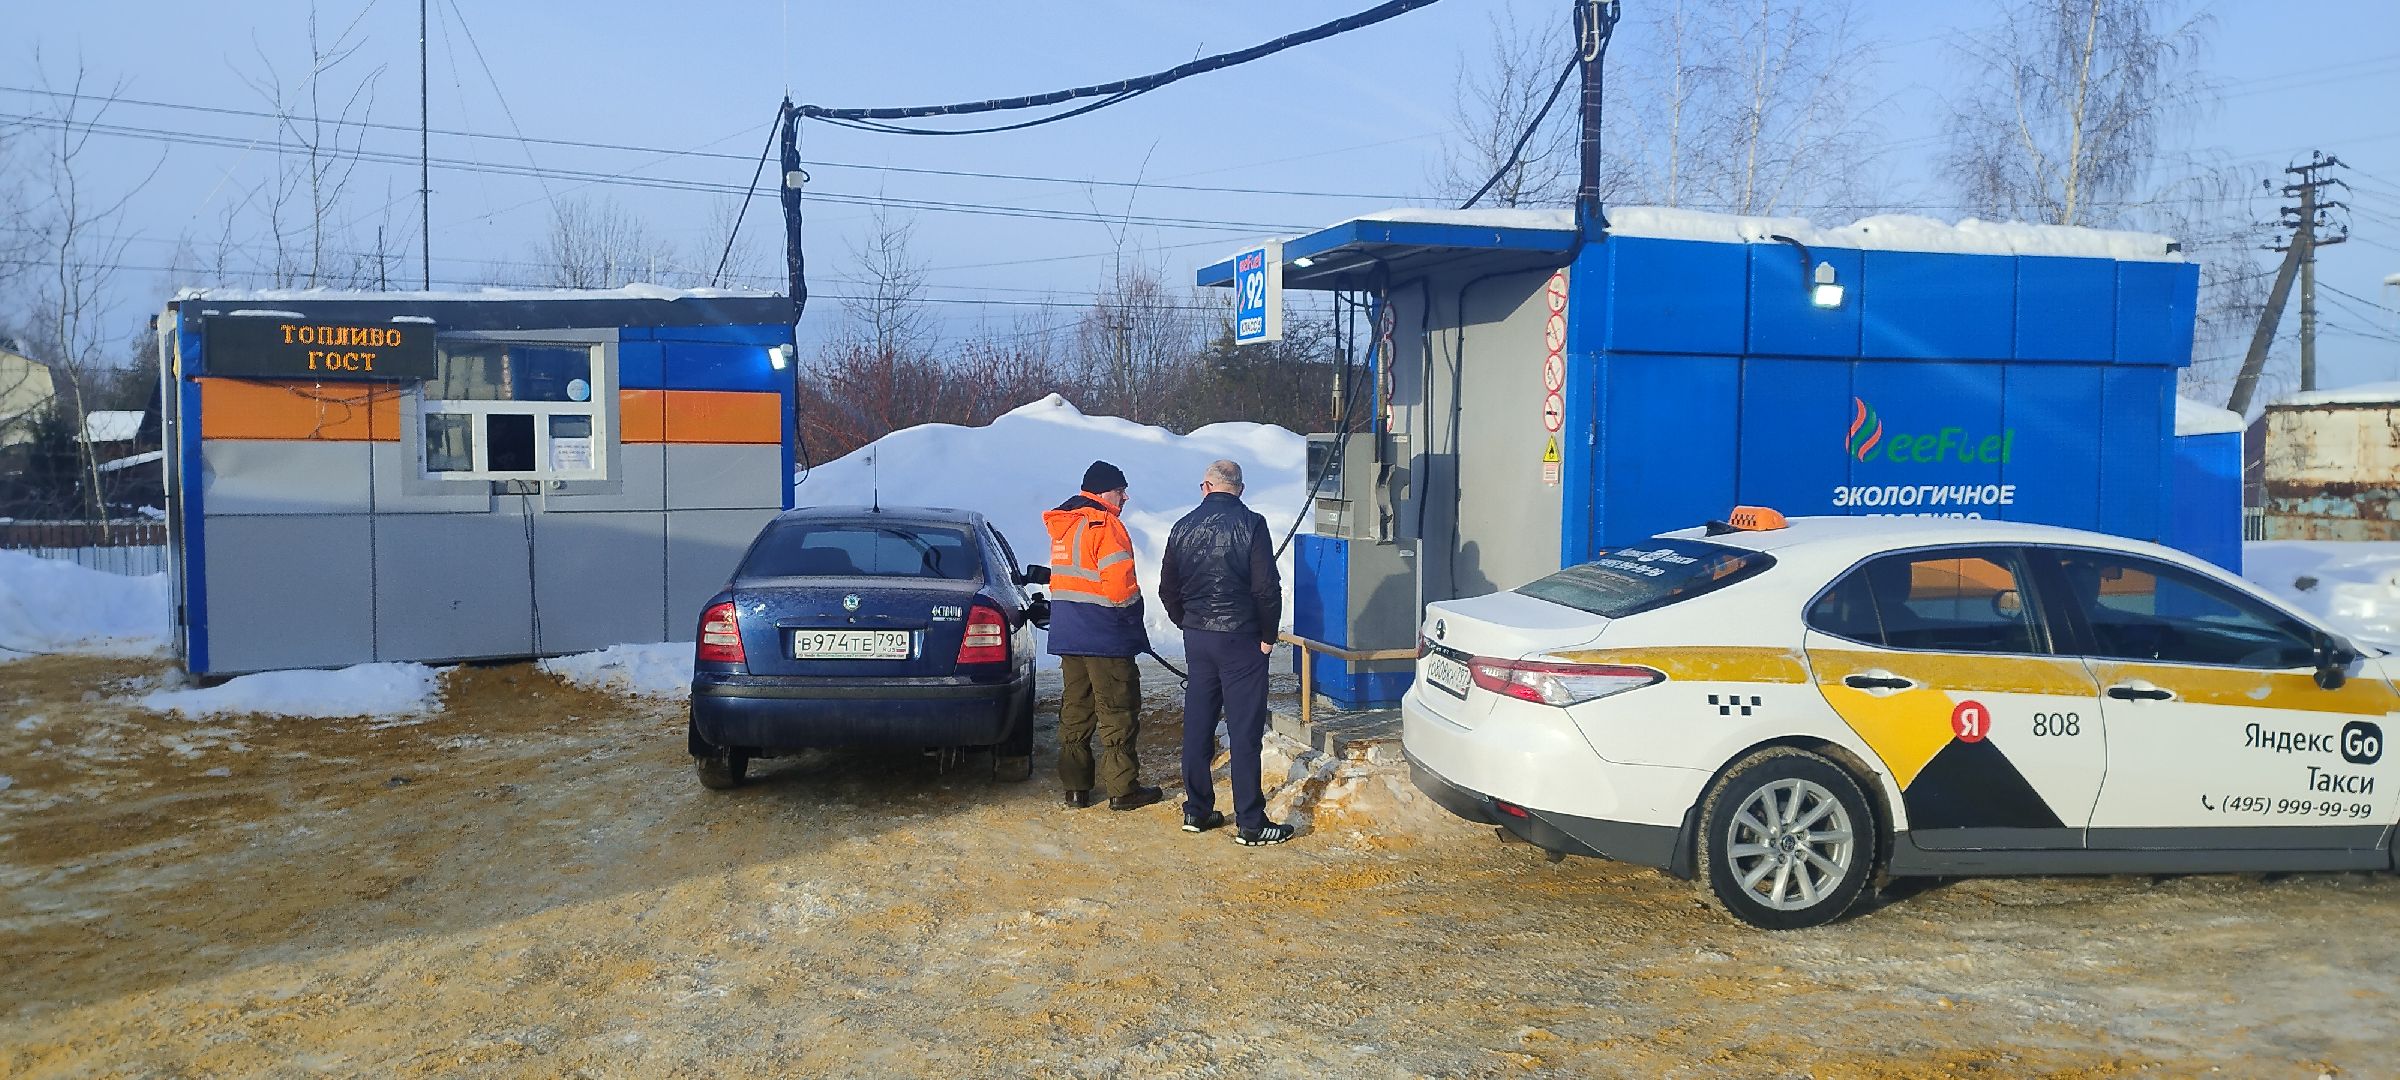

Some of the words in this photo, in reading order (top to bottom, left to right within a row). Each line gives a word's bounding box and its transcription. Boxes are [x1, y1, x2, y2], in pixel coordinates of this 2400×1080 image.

[1246, 271, 1264, 309] 92
[280, 324, 401, 347] ТОПЛИВО
[308, 350, 376, 371] ГОСТ
[1832, 484, 2017, 507] ЭКОЛОГИЧНОЕ
[801, 634, 873, 652] В974ТЕ
[876, 633, 904, 647] 790
[1960, 708, 1979, 737] Я
[2033, 712, 2080, 737] 808
[2244, 723, 2334, 753] Яндекс
[2344, 727, 2380, 759] Go
[2306, 765, 2375, 795] Такси
[2222, 795, 2272, 814] (495)
[2276, 798, 2372, 819] 999-99-99
